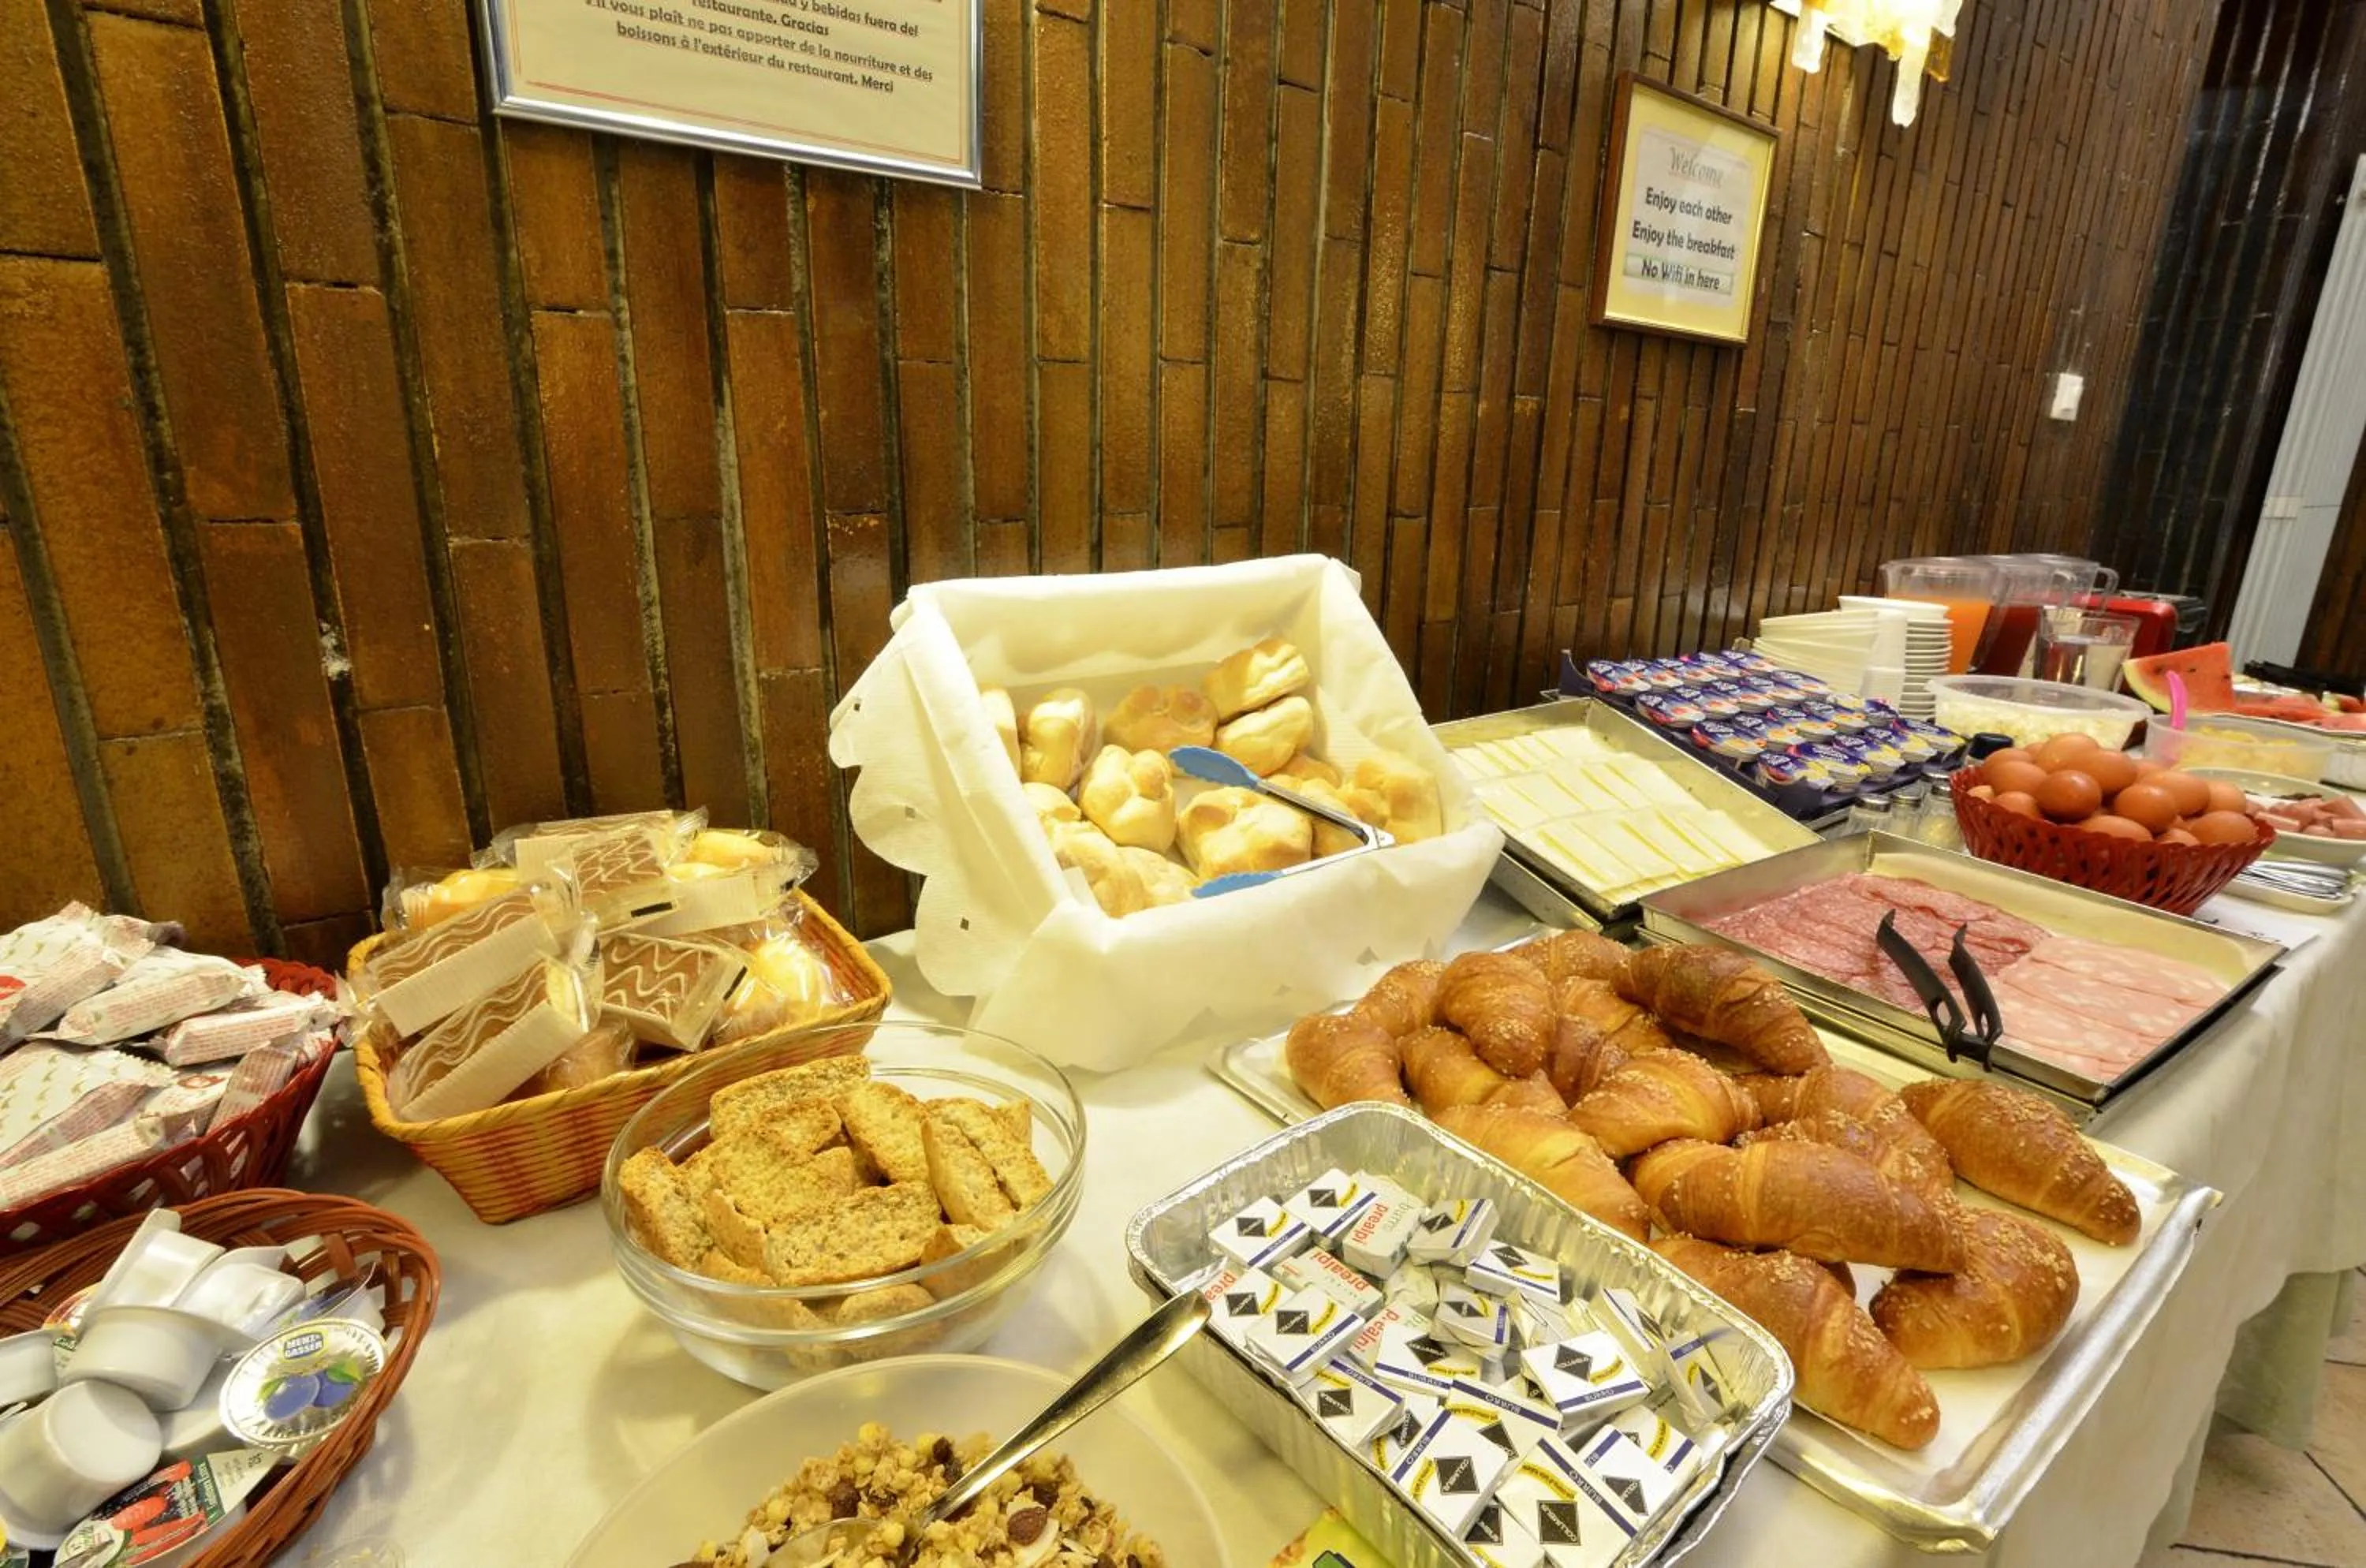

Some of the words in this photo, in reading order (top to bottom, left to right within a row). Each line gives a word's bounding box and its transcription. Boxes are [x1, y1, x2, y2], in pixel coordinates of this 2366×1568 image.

[692, 0, 777, 24] restaurante.
[781, 13, 829, 35] Gracias
[801, 0, 809, 11] y
[812, 0, 861, 24] bebidas
[864, 12, 897, 32] fuera
[900, 22, 919, 37] del
[610, 0, 644, 17] vous
[649, 7, 684, 25] plaît
[688, 16, 704, 29] ne
[709, 22, 732, 35] pas
[737, 28, 796, 49] apporter
[799, 39, 815, 54] de
[819, 43, 830, 58] la
[834, 49, 896, 73] nourriture
[898, 63, 911, 76] et
[914, 66, 933, 81] des
[617, 21, 677, 46] boissons
[681, 35, 690, 50] à
[694, 37, 763, 65] l'extérieur
[767, 54, 785, 69] du
[789, 61, 858, 86] restaurant.
[862, 74, 894, 92] Merci
[1669, 147, 1722, 189] Welcome
[1645, 186, 1677, 214] Enjoy
[1679, 200, 1703, 218] each
[1705, 204, 1733, 224] other
[1632, 219, 1664, 248] Enjoy
[1666, 229, 1684, 248] the
[1687, 231, 1735, 260] breakfast
[1641, 258, 1658, 278] No
[1662, 262, 1682, 283] Wifi
[1685, 268, 1695, 285] in
[1696, 268, 1720, 289] here
[1352, 1203, 1389, 1245] prealpi
[1204, 1271, 1237, 1301] prea
[1312, 1250, 1371, 1292] prealpi
[1584, 1388, 1615, 1402] BURRO
[1568, 1469, 1604, 1504] BURRO
